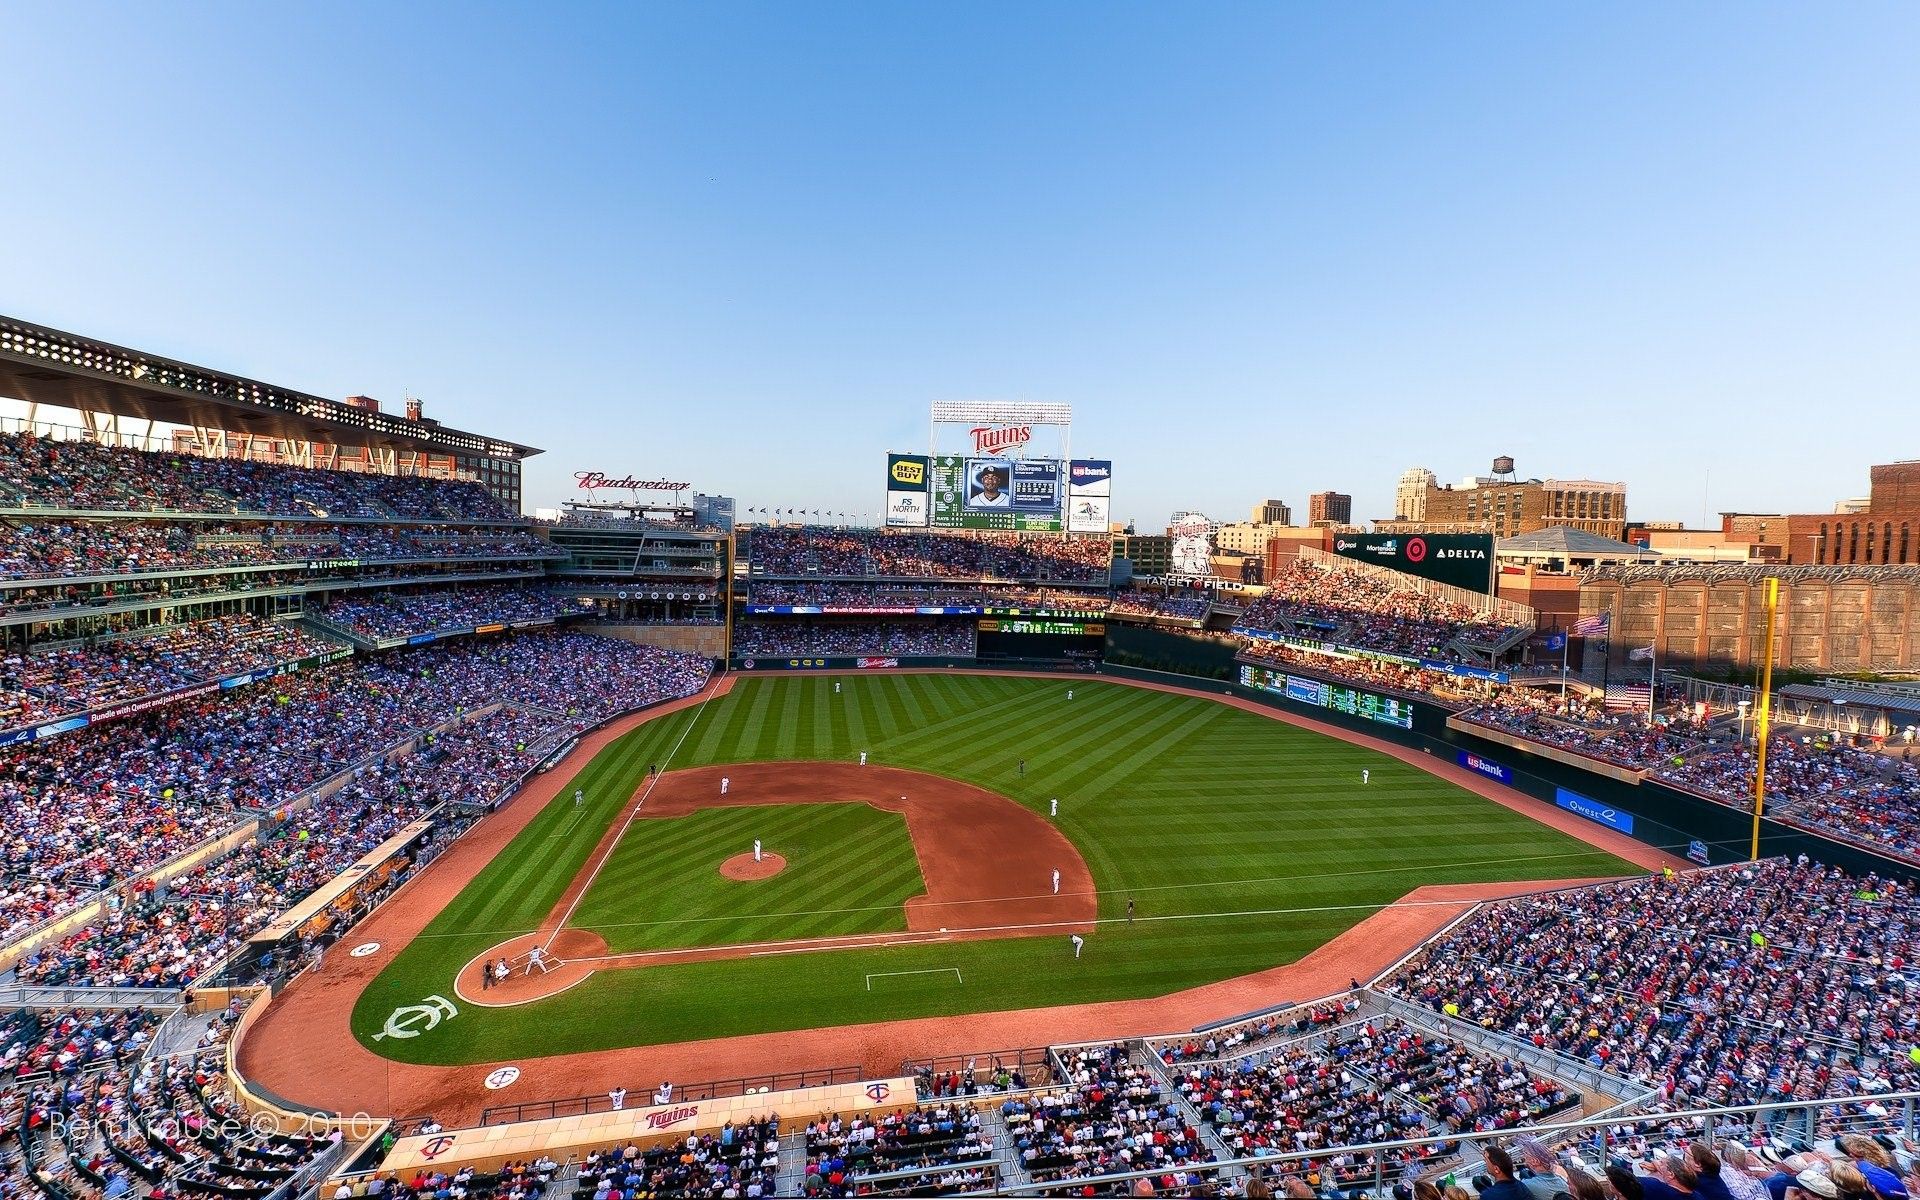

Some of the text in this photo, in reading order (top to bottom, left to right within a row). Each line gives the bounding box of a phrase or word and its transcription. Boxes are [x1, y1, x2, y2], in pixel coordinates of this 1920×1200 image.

[970, 426, 1031, 453] Twins
[896, 465, 922, 473] BEST
[574, 471, 690, 490] Budweiser
[1448, 550, 1484, 558] DELTA
[1146, 577, 1244, 590] TARGET FIELD
[92, 710, 115, 722] Bundle
[116, 705, 130, 715] with
[132, 702, 151, 713] Qwest
[152, 698, 163, 706] and
[163, 696, 174, 706] join
[185, 688, 205, 699] winning
[205, 683, 220, 692] team!
[1289, 690, 1306, 700] Qwest
[1570, 801, 1600, 818] Qwest
[646, 1106, 698, 1129] Twins
